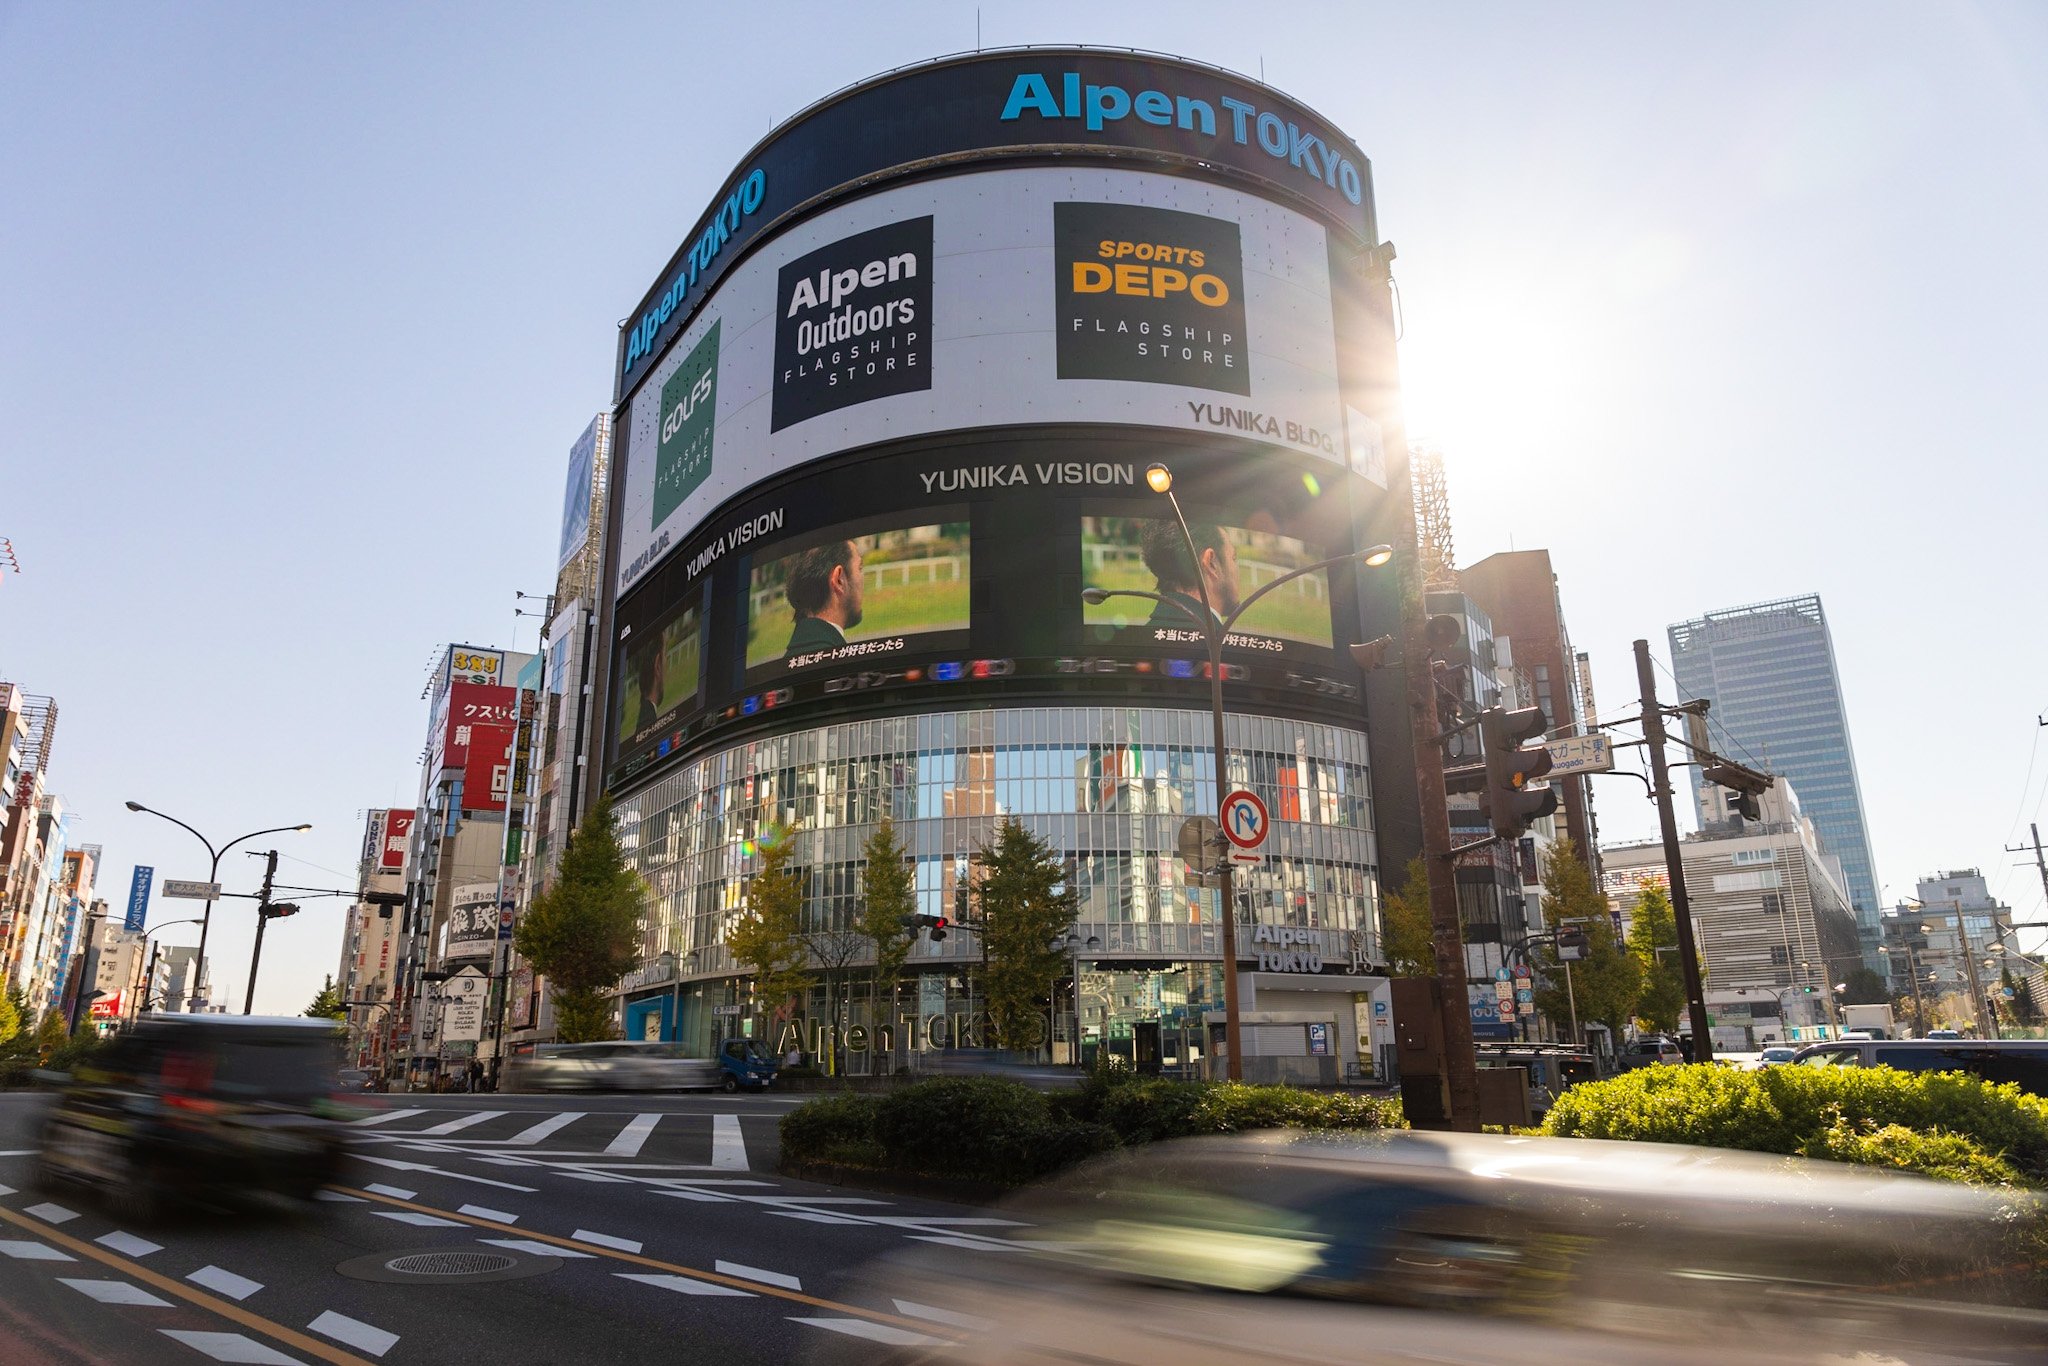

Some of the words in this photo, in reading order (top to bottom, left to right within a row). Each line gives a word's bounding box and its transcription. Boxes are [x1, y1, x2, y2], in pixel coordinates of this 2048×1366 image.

[1000, 72, 1216, 136] Alpen
[1220, 96, 1361, 206] TOKYO
[1098, 240, 1205, 267] SPORTS
[624, 272, 688, 374] Alpen
[688, 168, 766, 287] TOKYO
[787, 252, 917, 318] Alpen
[1072, 262, 1230, 307] DEPO
[797, 297, 915, 355] Outdoors
[1073, 318, 1232, 346] FLAGSHIP
[784, 332, 917, 384] FLAGSHIP
[829, 352, 917, 386] STORE
[1138, 342, 1233, 368] STORE
[662, 367, 712, 444] GOLF5
[1188, 401, 1282, 438] YUNIKA
[1286, 421, 1338, 456] BLDG.
[658, 427, 710, 488] FLAGSHIP
[675, 446, 708, 488] STORE
[920, 464, 1029, 494] YUNIKA
[1035, 462, 1134, 485] VISION
[686, 536, 726, 581] YUNIKA
[728, 508, 784, 550] VISION
[621, 549, 649, 587] YUNIKA
[788, 637, 905, 669] 本当にボートが好きだったら
[1154, 629, 1284, 652] 本当にボーが好きだったら
[453, 652, 499, 674] 389
[491, 764, 510, 792] G
[396, 818, 415, 829] ク
[1254, 924, 1320, 949] Alpen
[1258, 952, 1323, 974] TOKYO
[1375, 1002, 1386, 1016] P
[776, 1016, 895, 1064] Alpen
[1311, 1026, 1319, 1039] P
